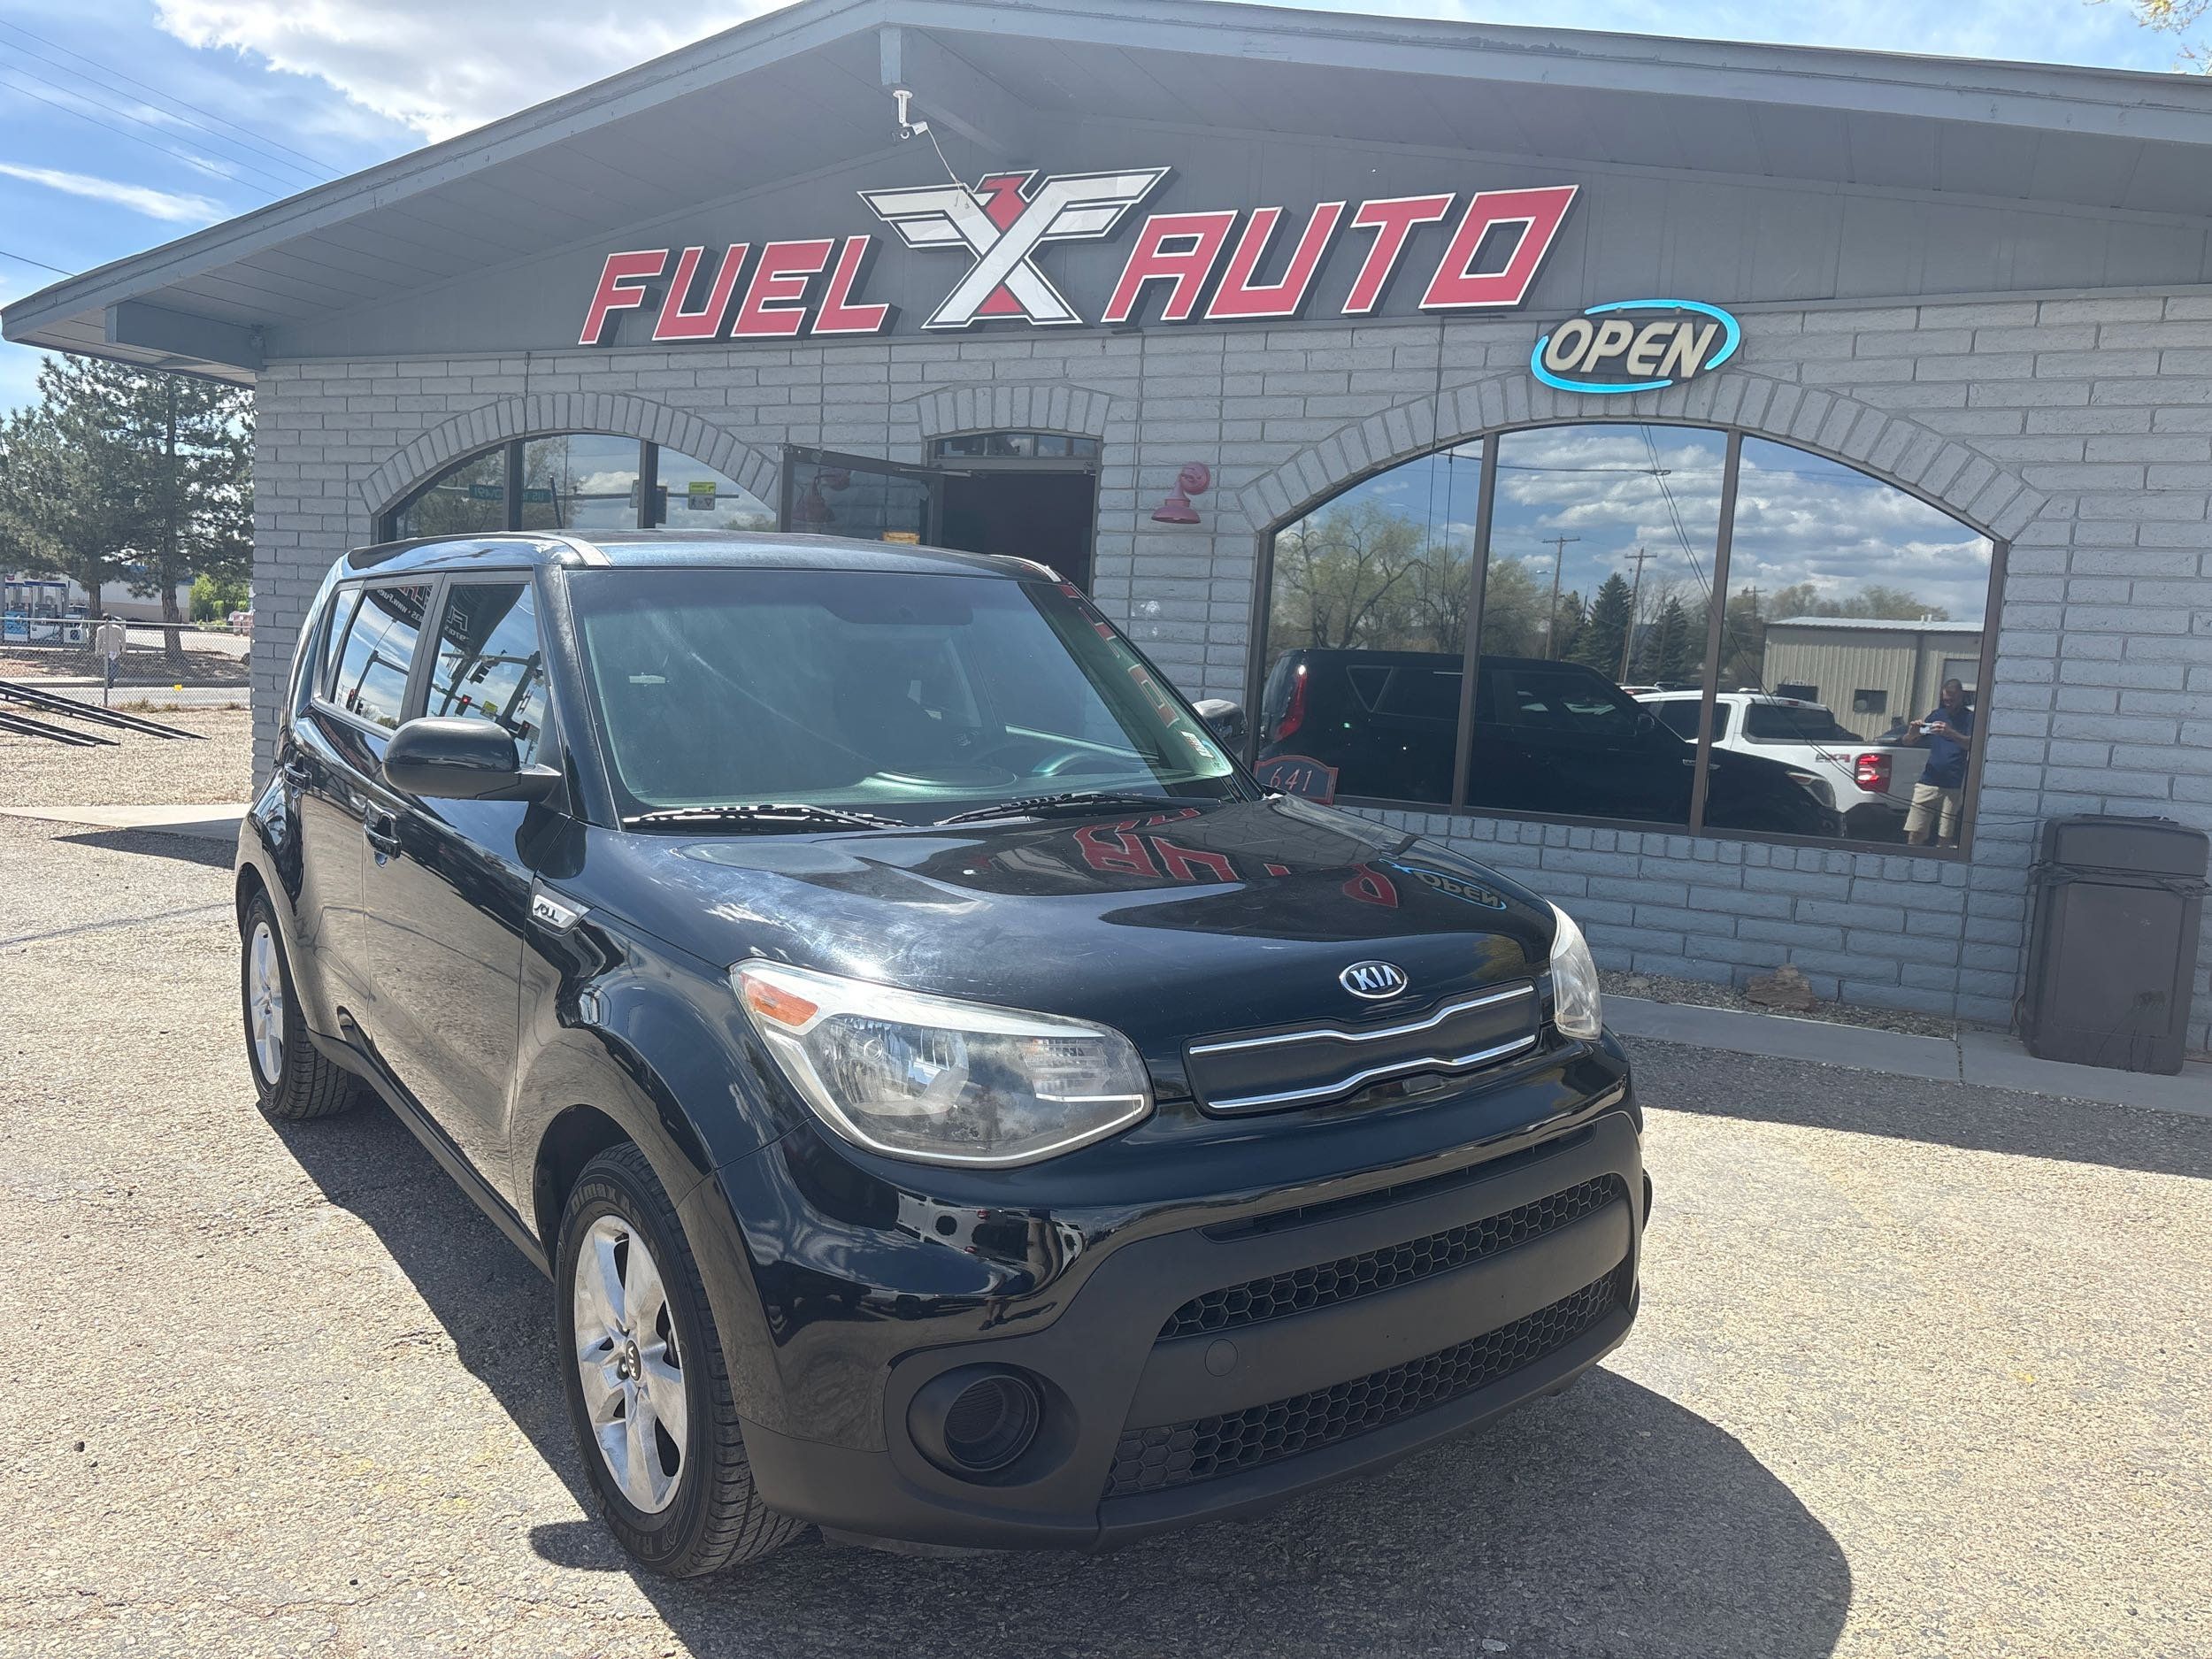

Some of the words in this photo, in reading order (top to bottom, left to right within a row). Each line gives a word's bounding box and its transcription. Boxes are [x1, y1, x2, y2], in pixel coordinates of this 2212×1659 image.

[578, 234, 890, 345] FUEL
[1101, 184, 1580, 322] AUTO
[1546, 318, 1720, 379] OPEN
[1271, 766, 1312, 791] 641
[1349, 964, 1402, 991] KIA
[628, 1346, 637, 1377] KIA
